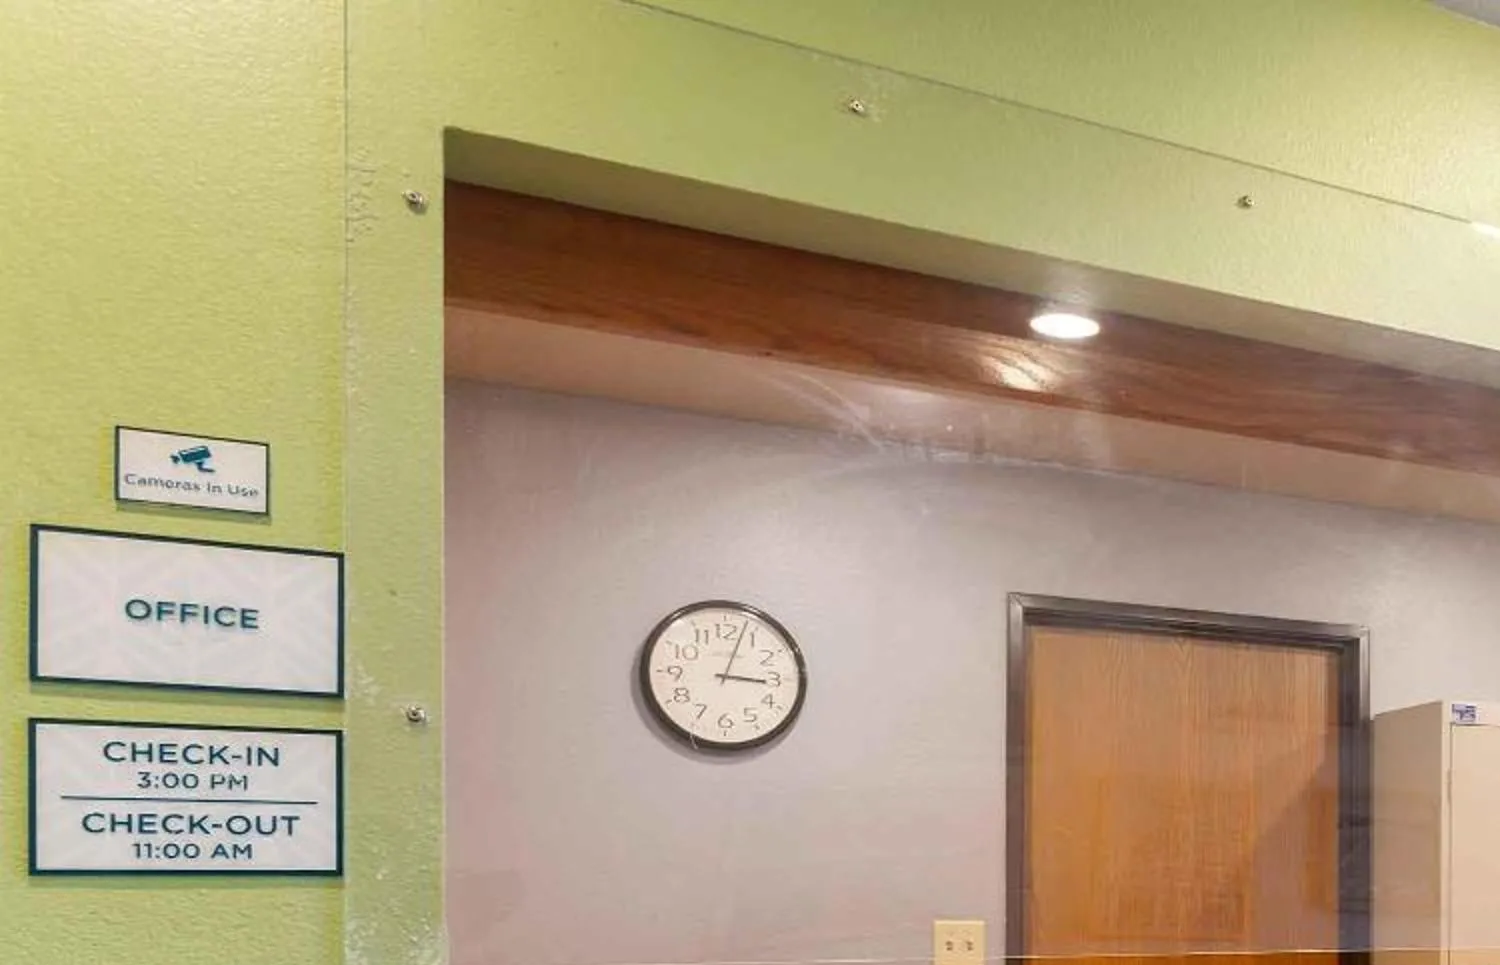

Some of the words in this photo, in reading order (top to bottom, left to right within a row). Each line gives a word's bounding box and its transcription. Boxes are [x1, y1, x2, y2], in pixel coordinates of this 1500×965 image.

[124, 473, 201, 492] Cameras
[227, 483, 259, 498] Use
[125, 599, 260, 629] OFFICE
[695, 629, 709, 645] 11
[715, 623, 738, 641] 12
[750, 631, 755, 648] 1
[675, 644, 699, 660] 10
[760, 650, 775, 666] 2
[667, 665, 684, 681] 9
[767, 671, 781, 687] 3
[673, 687, 690, 703] 8
[761, 693, 776, 708] 4
[694, 703, 708, 719] 7
[743, 707, 757, 722] 5
[717, 712, 733, 729] 6
[103, 741, 280, 767] CHECK-IN
[137, 772, 200, 790] 3:00
[210, 774, 249, 791] PM
[81, 812, 300, 836] CHECK-OUT
[132, 843, 200, 859] 11:00
[210, 844, 253, 860] AM
